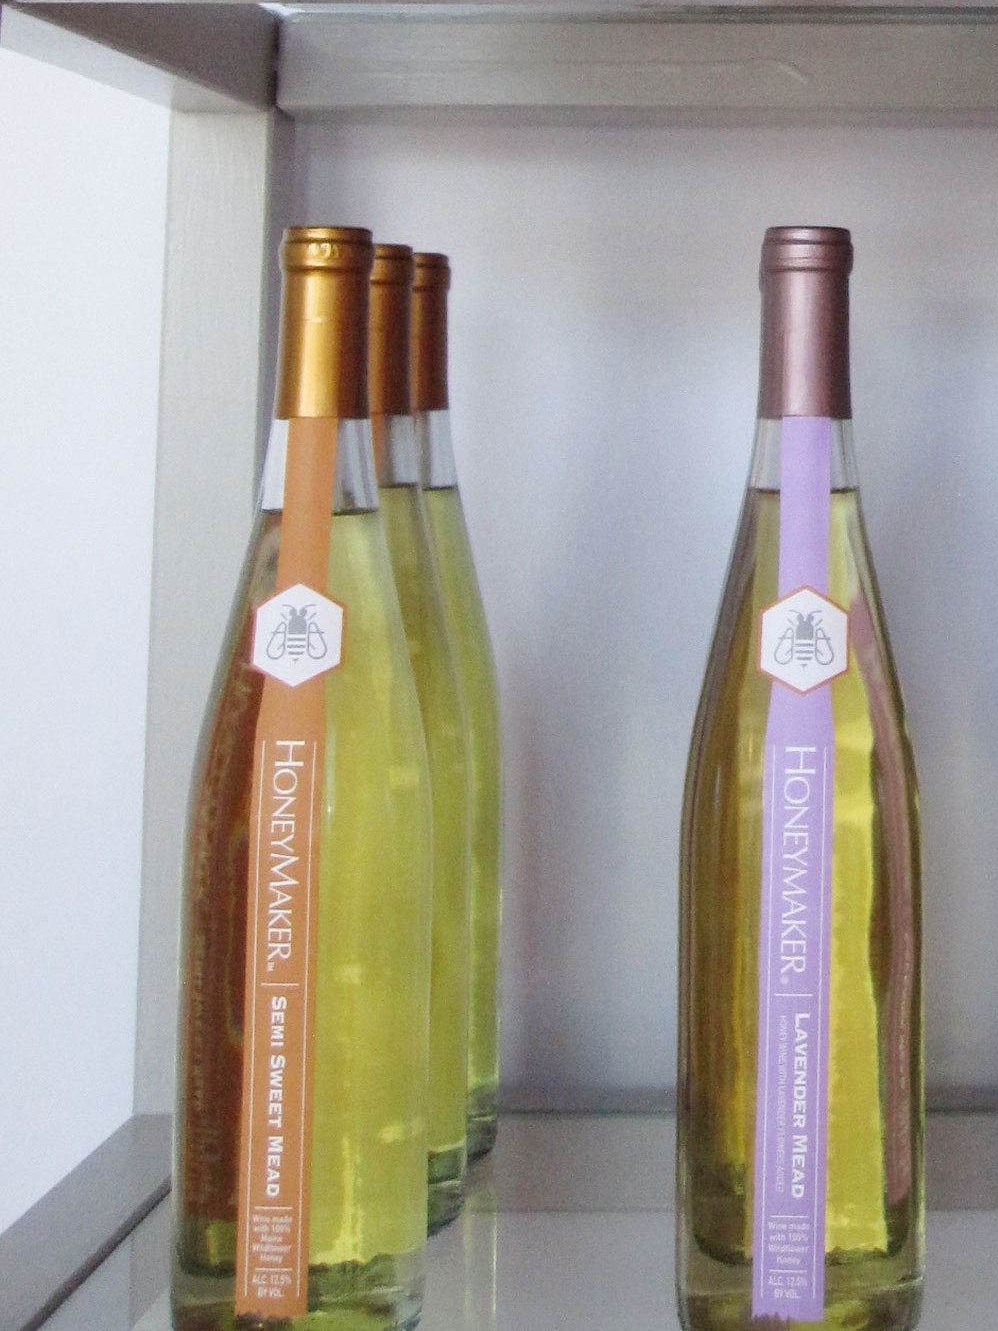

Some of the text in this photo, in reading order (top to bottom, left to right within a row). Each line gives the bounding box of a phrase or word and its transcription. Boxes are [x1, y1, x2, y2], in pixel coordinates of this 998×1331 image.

[265, 996, 287, 1197] SEMI SWEET MEAD
[791, 1013, 810, 1199] LAVENDER MEAD
